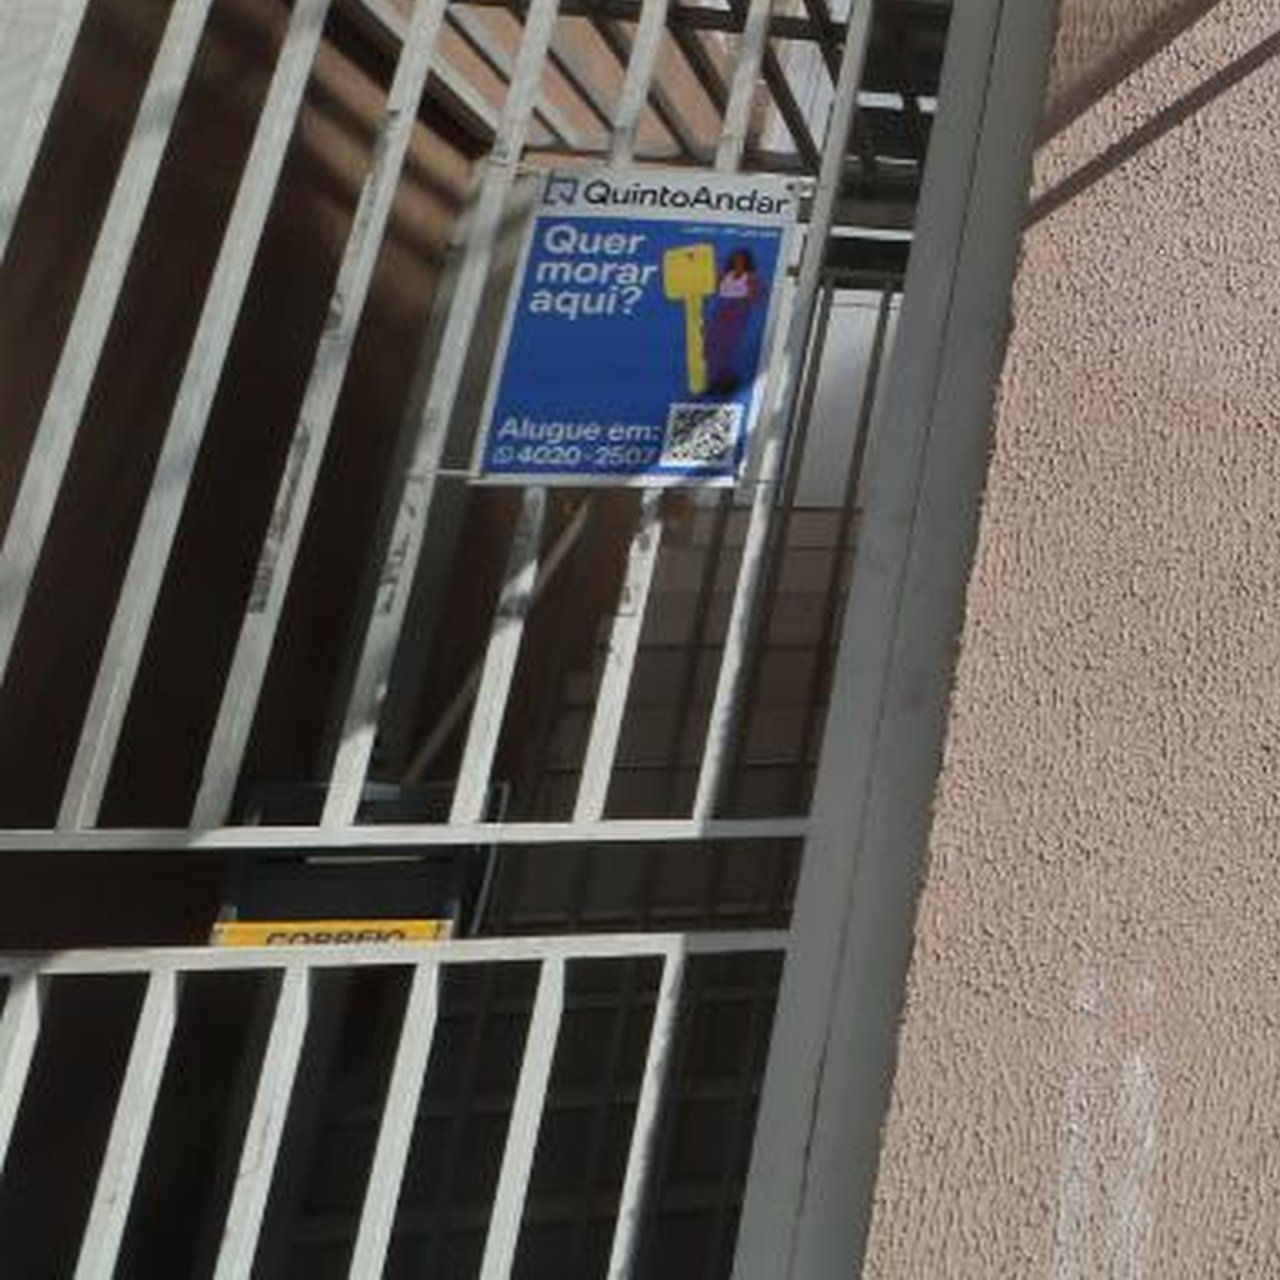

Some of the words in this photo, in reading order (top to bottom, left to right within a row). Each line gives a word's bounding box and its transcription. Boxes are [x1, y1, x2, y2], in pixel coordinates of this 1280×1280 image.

[583, 180, 790, 214] QuintoAndar
[543, 224, 647, 256] Quer
[535, 259, 657, 287] morar
[529, 286, 643, 320] aqui?
[498, 417, 600, 443] Alugue
[608, 423, 661, 441] em:
